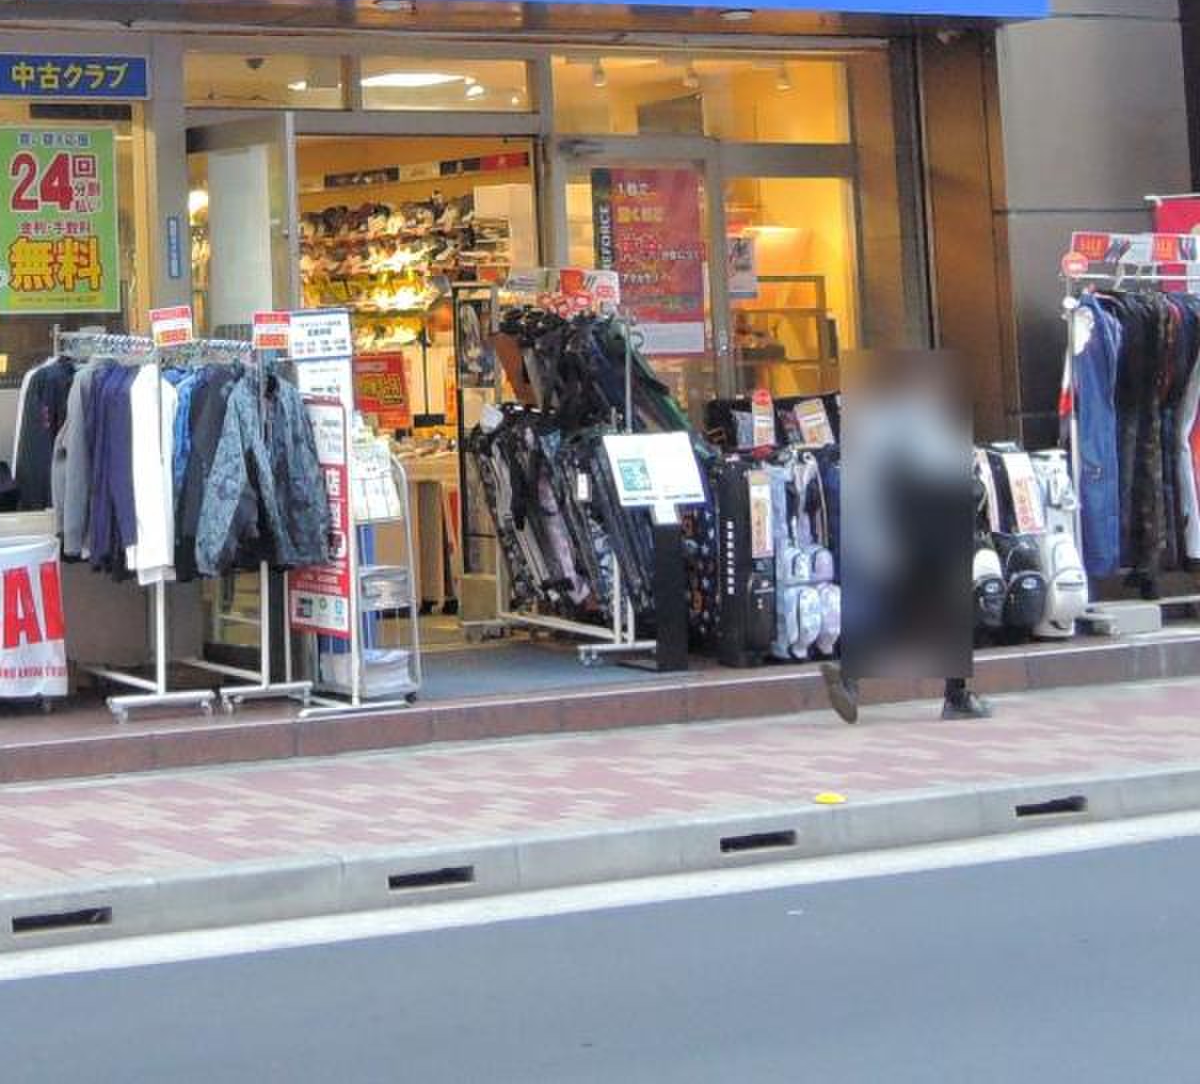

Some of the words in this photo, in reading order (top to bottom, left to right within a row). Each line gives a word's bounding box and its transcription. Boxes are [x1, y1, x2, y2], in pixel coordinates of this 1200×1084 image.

[10, 62, 130, 91] 中古クラブ
[8, 236, 104, 292] 無料
